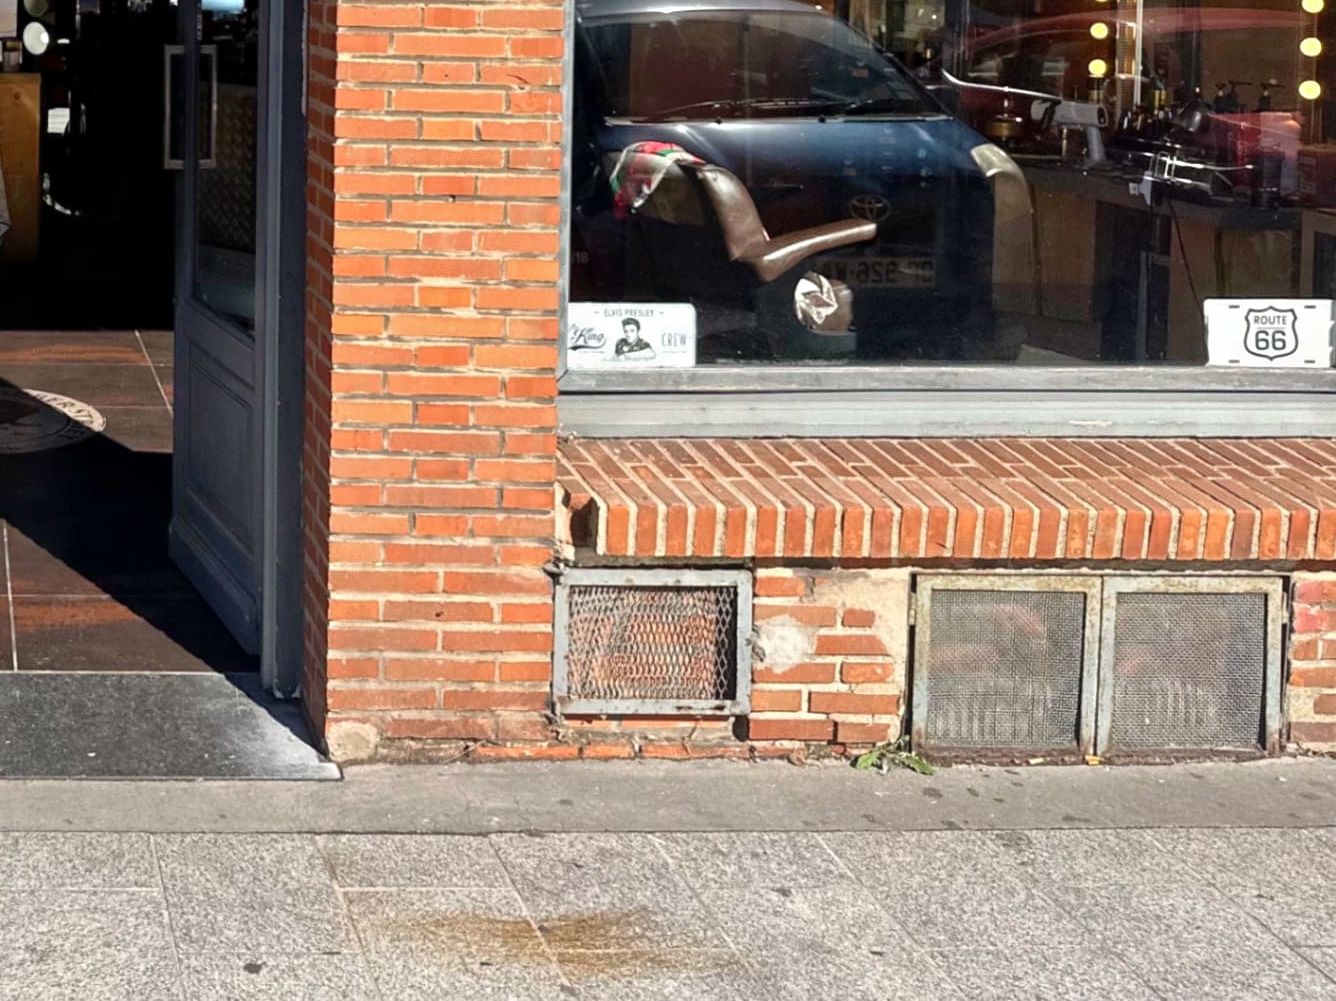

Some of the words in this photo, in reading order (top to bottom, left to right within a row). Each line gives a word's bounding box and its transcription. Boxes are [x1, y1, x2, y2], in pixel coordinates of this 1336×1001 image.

[604, 307, 623, 318] ELVIS
[624, 308, 655, 318] PRESLEY
[1253, 315, 1288, 326] ROUTE
[570, 326, 606, 345] King
[661, 332, 688, 348] CREW
[1255, 330, 1287, 351] 66
